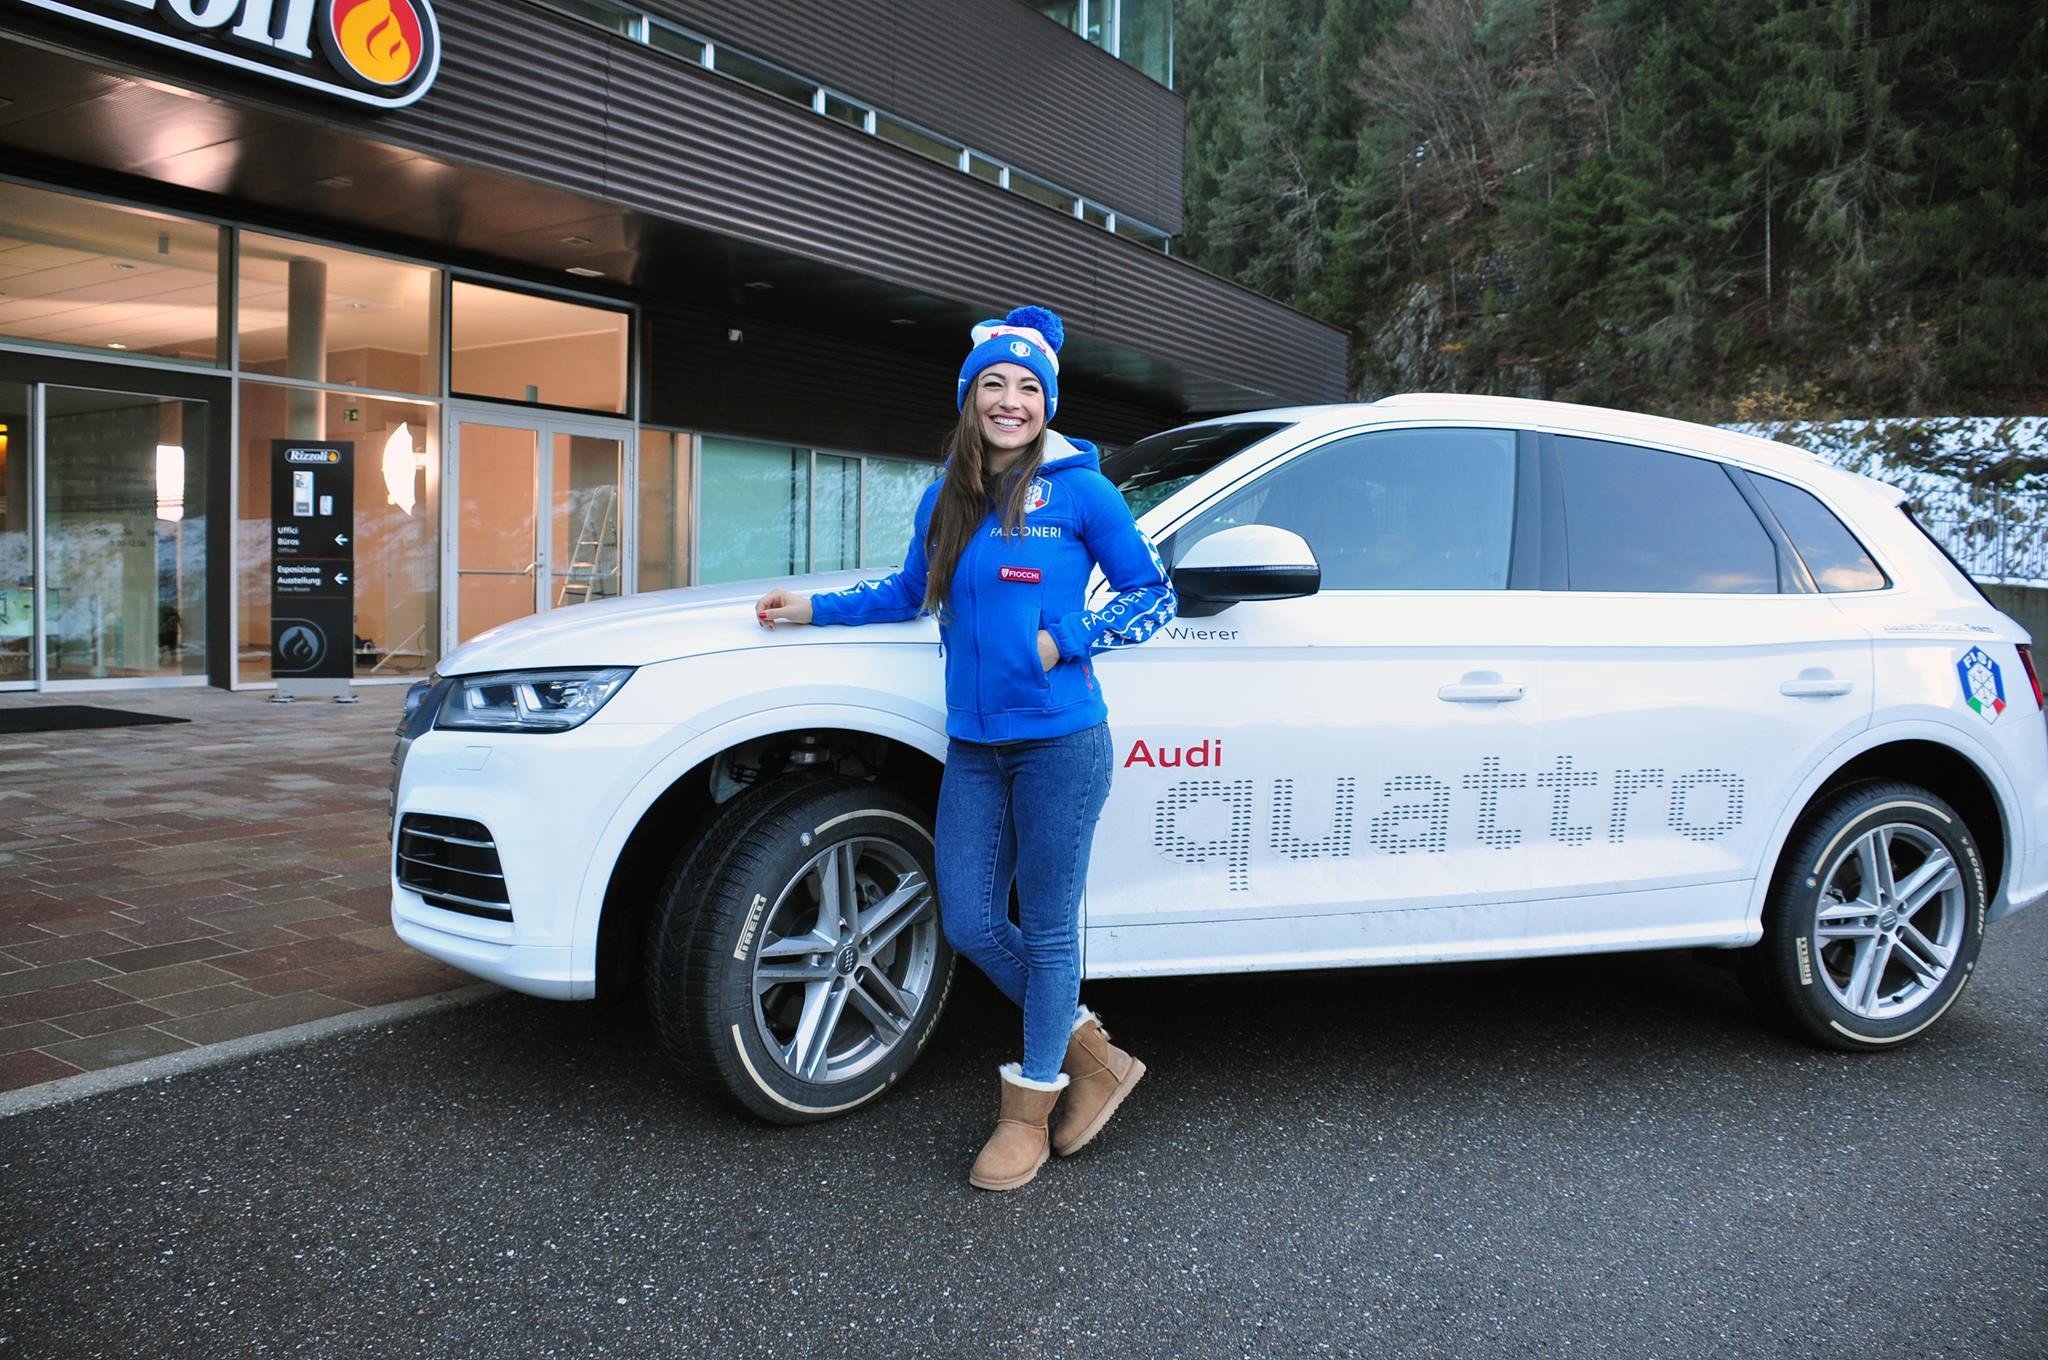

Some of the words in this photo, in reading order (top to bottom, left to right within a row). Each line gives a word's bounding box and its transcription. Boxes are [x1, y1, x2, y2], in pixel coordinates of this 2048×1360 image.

[289, 449, 328, 462] Rizzoli
[277, 526, 298, 535] Uffici
[277, 537, 300, 546] Büros
[277, 565, 320, 575] Esposizione
[1008, 570, 1040, 580] FIOCCHI
[277, 576, 322, 587] Ausstellung
[1164, 626, 1239, 641] Wierer
[1962, 651, 1993, 671] FISI
[1124, 739, 1222, 768] Audi
[1154, 756, 1745, 893] quattro
[733, 893, 767, 961] PIRELLI
[1795, 936, 1812, 986] PIRELLI
